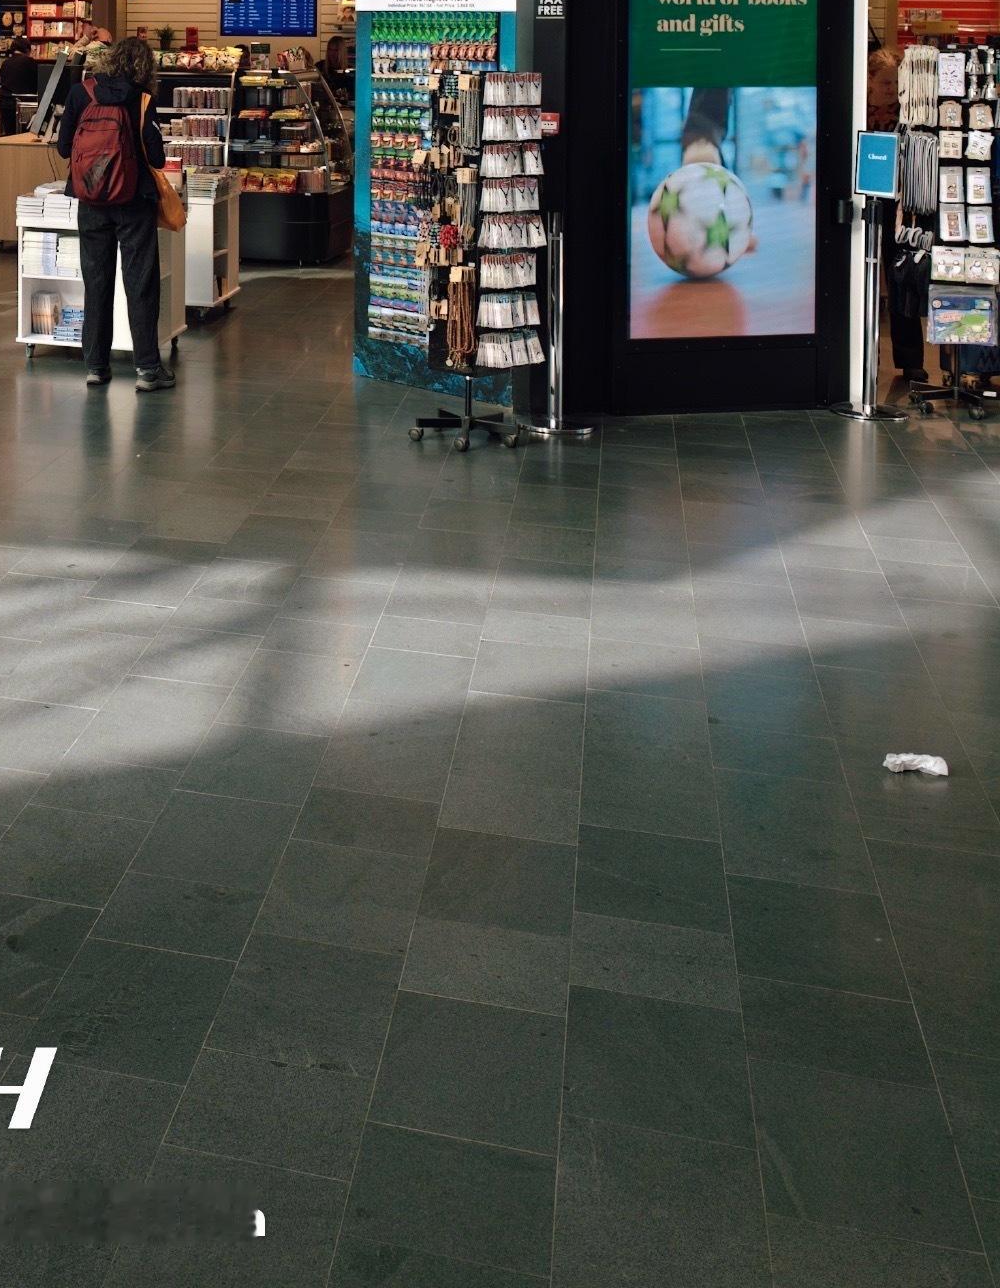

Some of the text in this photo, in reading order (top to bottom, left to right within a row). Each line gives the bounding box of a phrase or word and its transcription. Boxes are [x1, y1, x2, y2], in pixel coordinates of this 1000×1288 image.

[537, 5, 564, 16] FREE
[656, 13, 745, 37] and gifts
